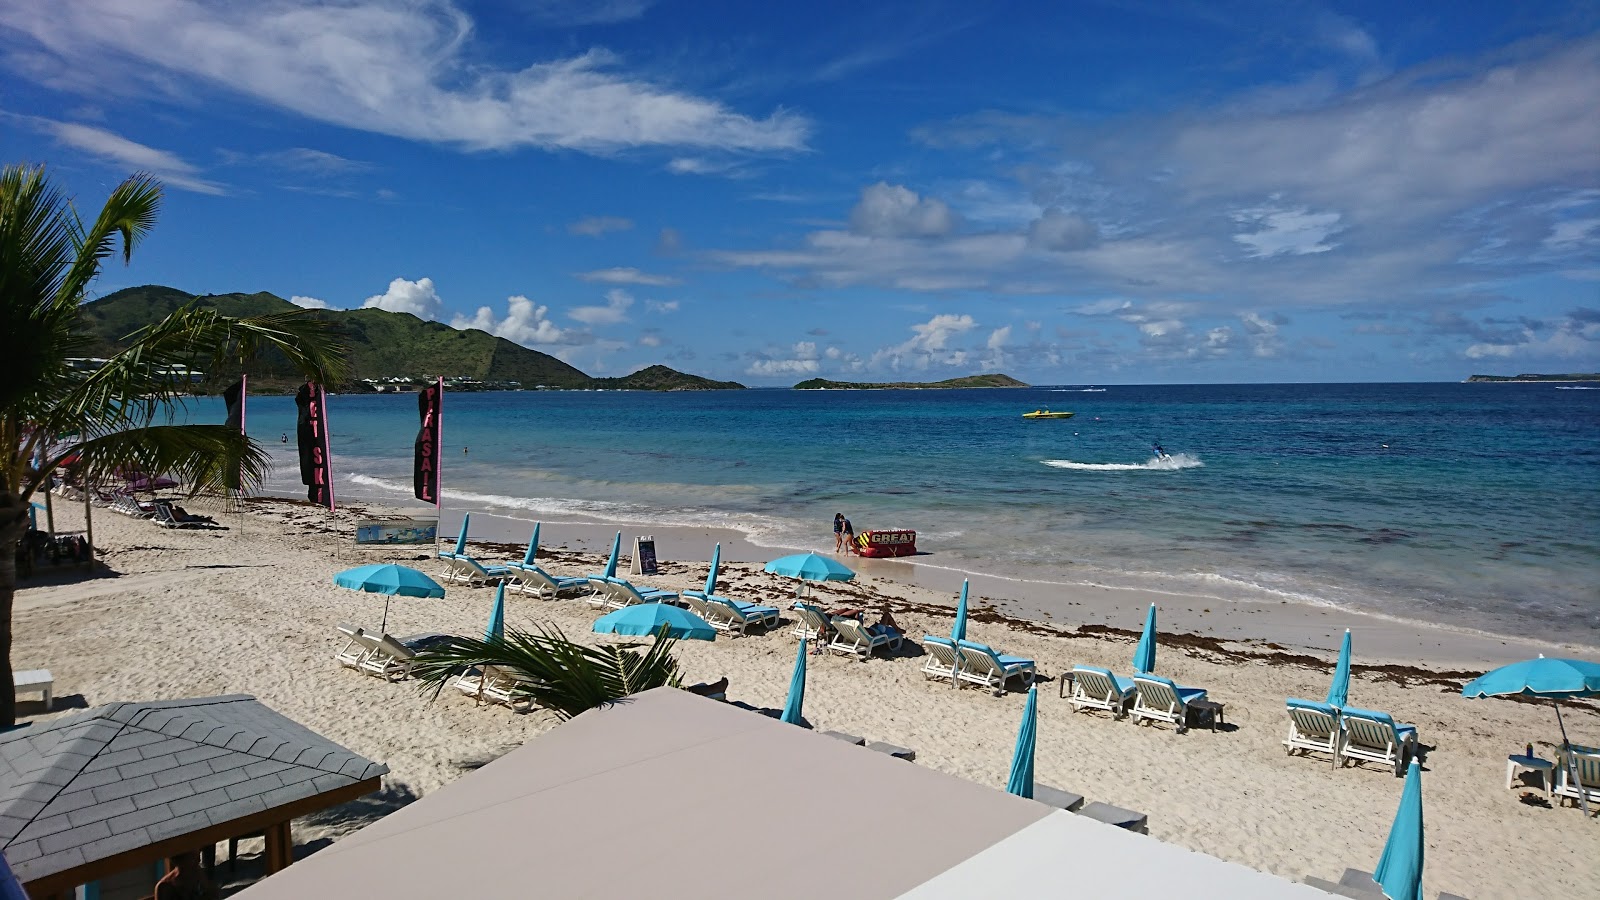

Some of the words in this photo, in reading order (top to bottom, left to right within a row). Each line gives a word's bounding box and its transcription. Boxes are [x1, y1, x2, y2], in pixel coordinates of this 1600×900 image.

[421, 387, 436, 501] PARASAIL
[313, 446, 325, 503] SKI
[871, 533, 916, 543] GREAT
